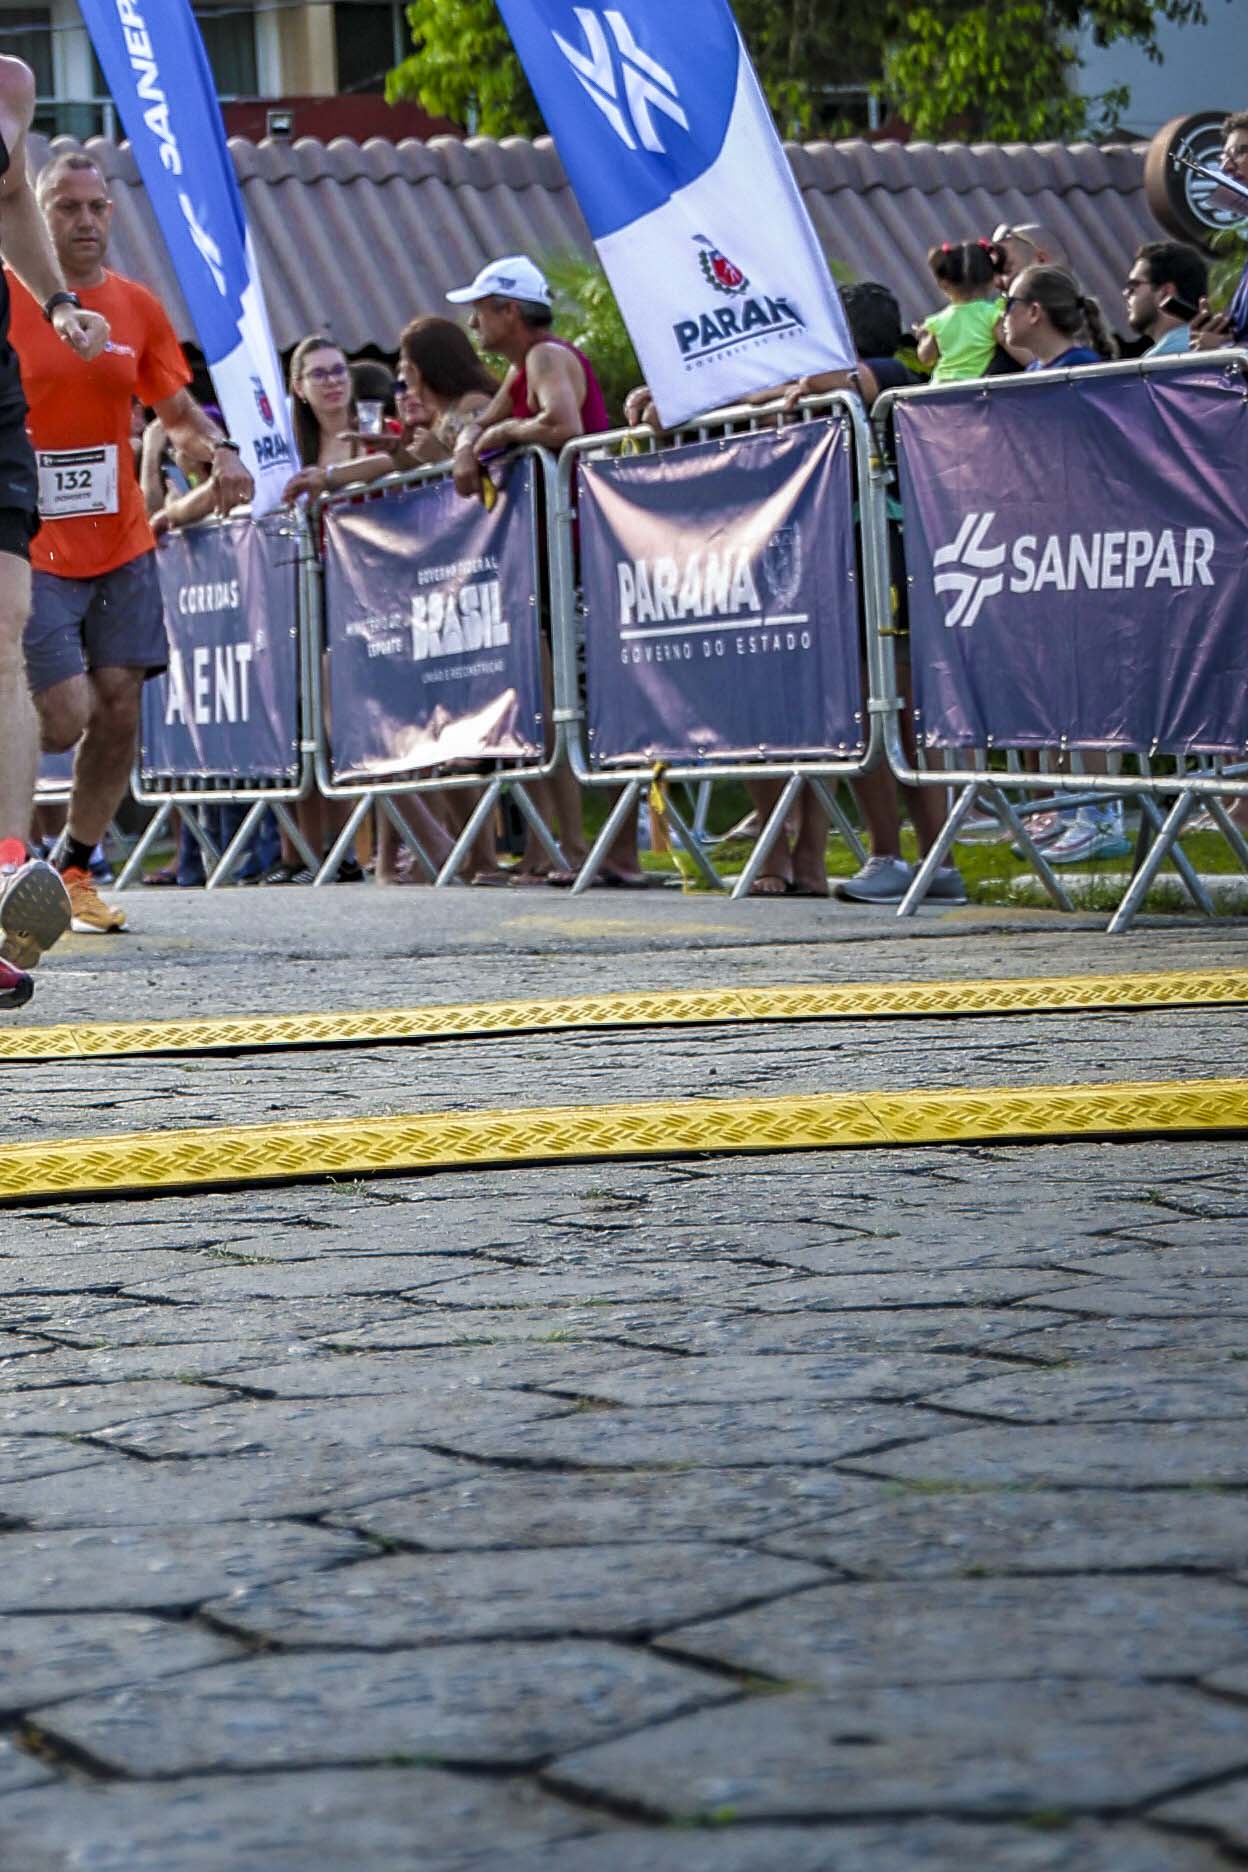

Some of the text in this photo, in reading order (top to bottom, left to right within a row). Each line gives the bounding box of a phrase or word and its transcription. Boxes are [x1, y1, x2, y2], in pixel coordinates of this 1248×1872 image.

[55, 469, 93, 492] 132
[1009, 527, 1216, 595] SANEPAR
[178, 580, 239, 615] CORRIDAS
[410, 580, 511, 661] BRASIL
[620, 630, 812, 665] GOVERNO DO ESTADO
